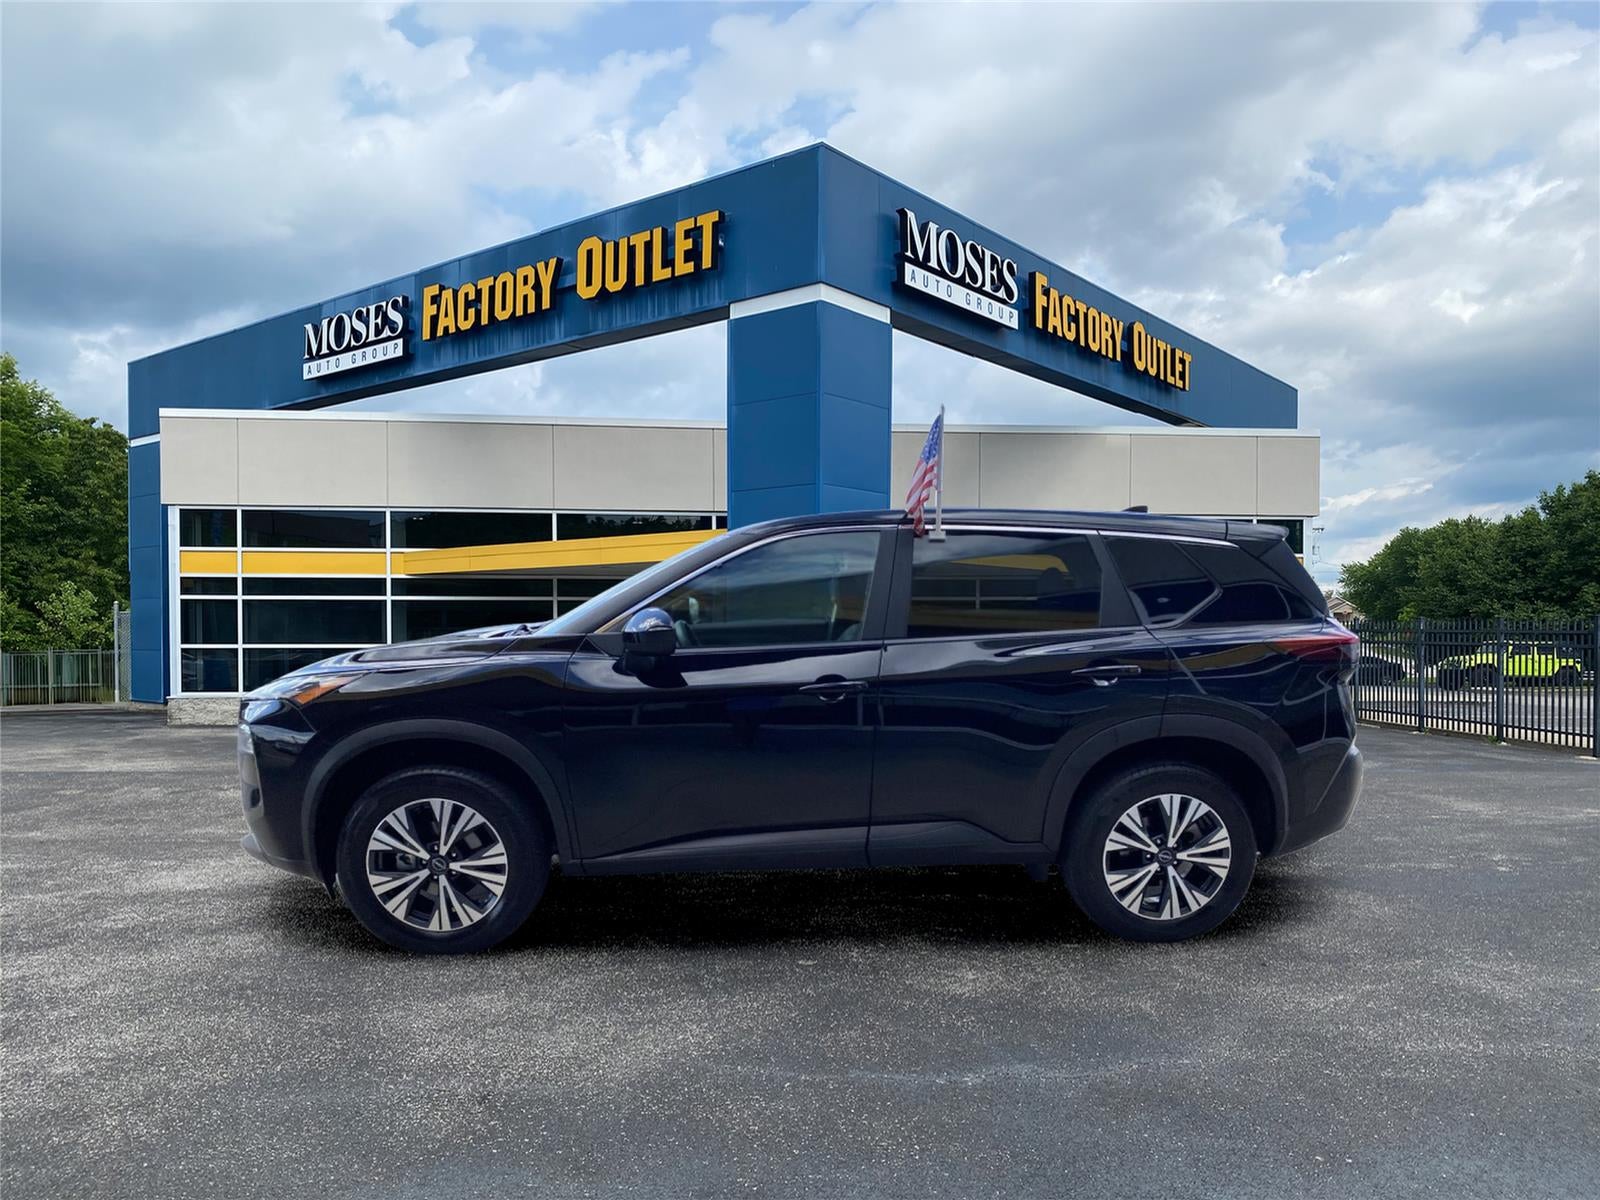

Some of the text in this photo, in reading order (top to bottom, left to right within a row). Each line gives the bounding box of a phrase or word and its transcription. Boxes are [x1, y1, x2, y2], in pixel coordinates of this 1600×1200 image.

[422, 210, 720, 340] FACTORY OUTLET
[904, 208, 1019, 304] MOSES
[303, 296, 404, 358] MOSES
[910, 269, 1015, 323] AUTO GROUP
[1035, 271, 1191, 391] FACTORY OUTLET
[307, 342, 399, 376] AUTO GROUP
